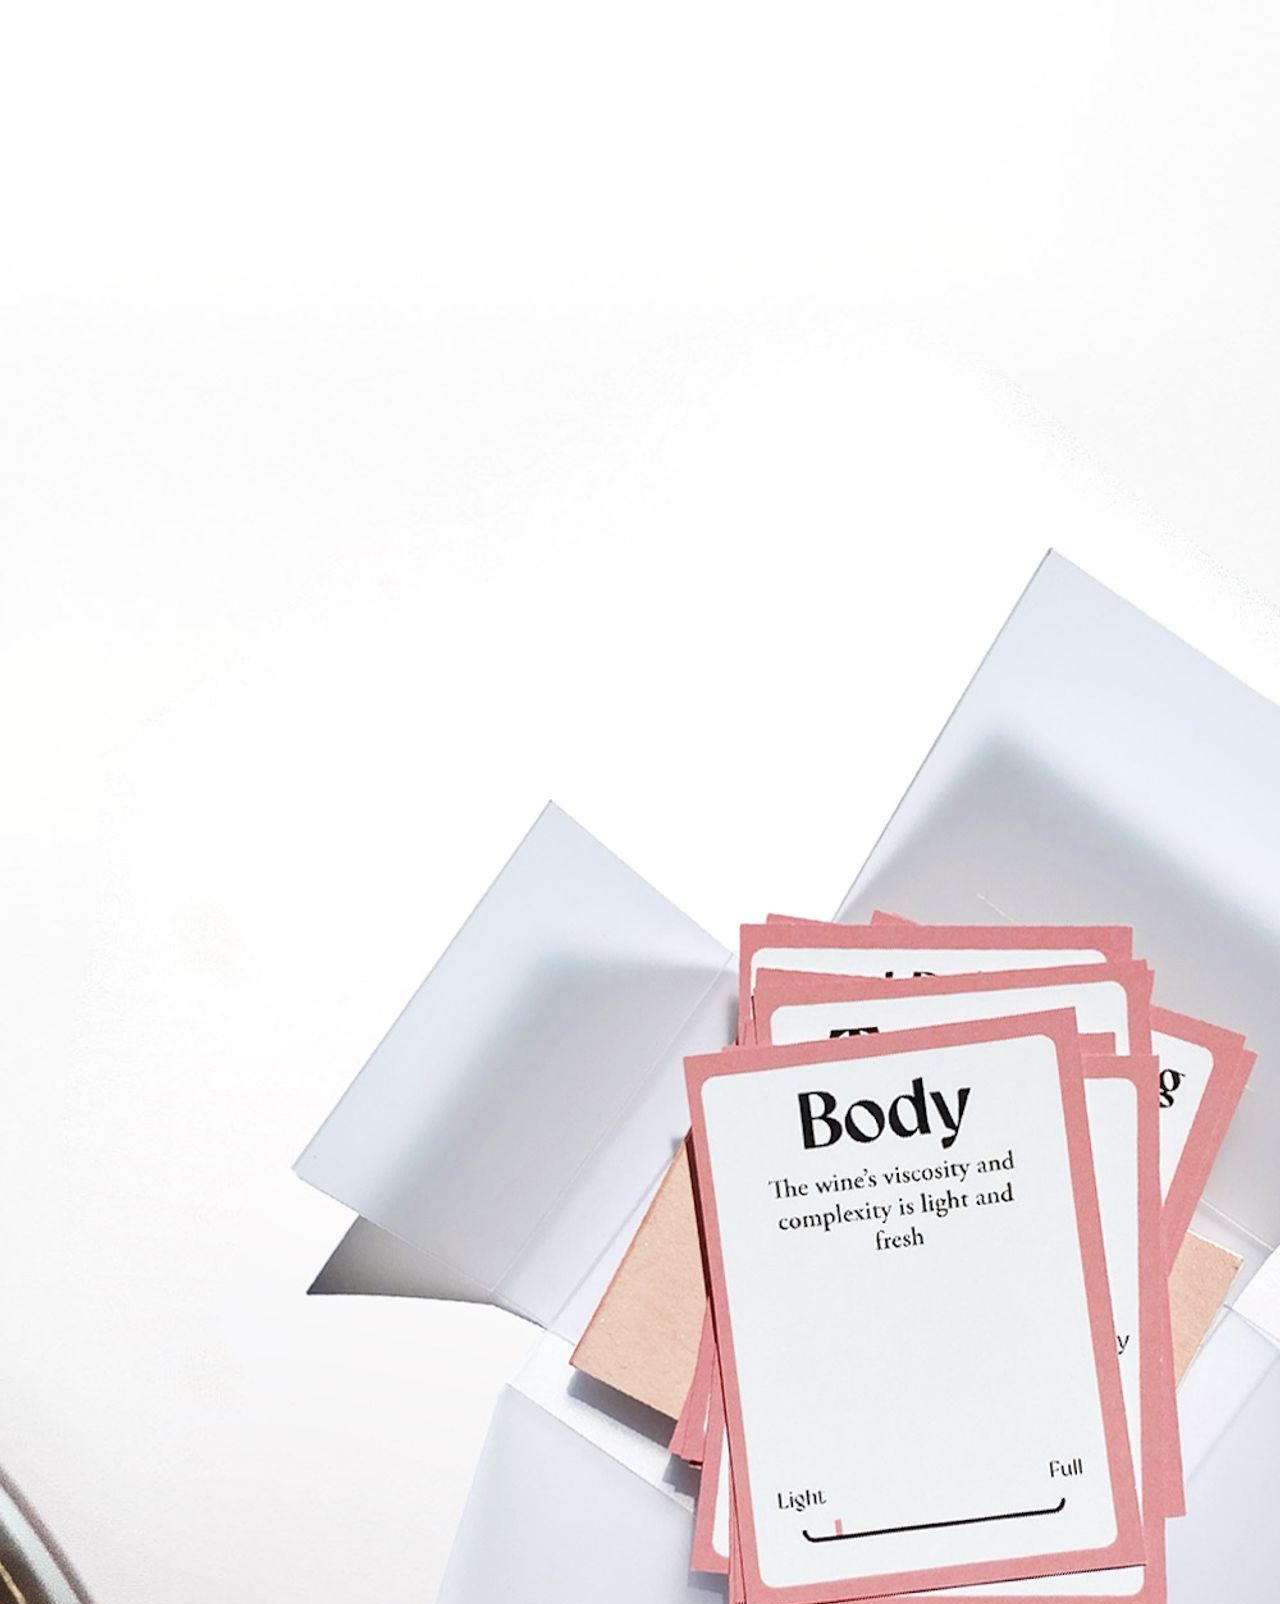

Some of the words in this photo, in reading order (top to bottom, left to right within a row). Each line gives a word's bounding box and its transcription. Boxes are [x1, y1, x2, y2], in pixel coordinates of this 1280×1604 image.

[797, 1076, 972, 1150] Body
[768, 1177, 809, 1199] The
[815, 1168, 878, 1194] wine’s
[882, 1159, 972, 1186] viscosity
[976, 1149, 1016, 1174] and
[778, 1203, 893, 1233] complexity
[898, 1196, 915, 1217] is
[919, 1188, 970, 1219] light
[975, 1180, 1016, 1206] and
[875, 1226, 926, 1251] fresh
[1049, 1457, 1084, 1479] Full
[776, 1488, 828, 1512] Light
